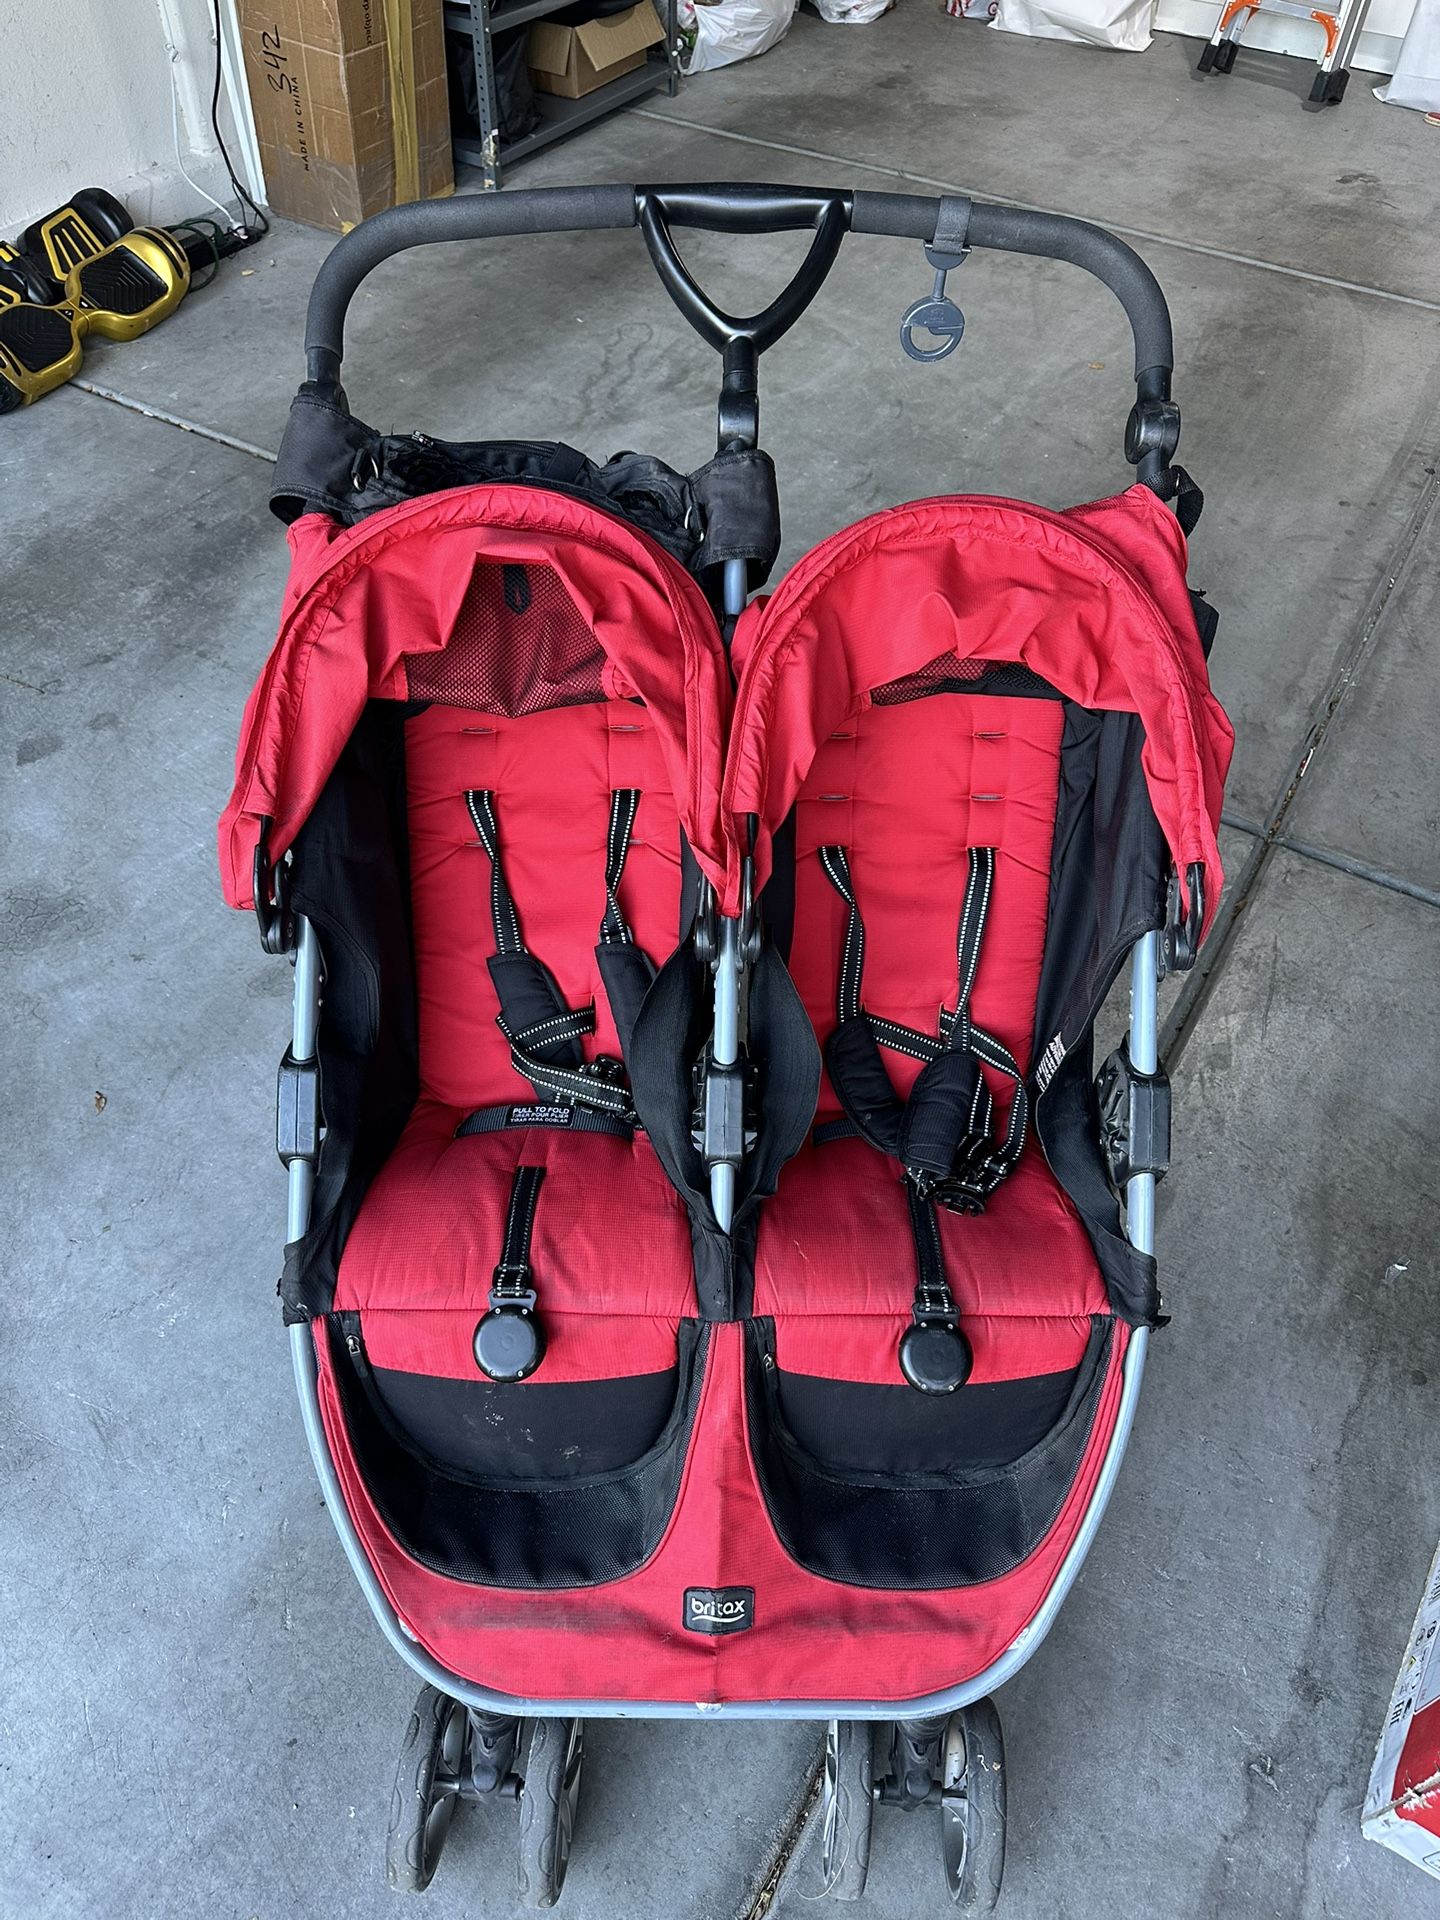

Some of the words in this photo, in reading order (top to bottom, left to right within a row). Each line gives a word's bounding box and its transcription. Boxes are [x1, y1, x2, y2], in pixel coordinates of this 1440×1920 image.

[262, 24, 292, 94] 342
[291, 76, 302, 116] CHINA
[297, 121, 305, 134] IN
[299, 138, 310, 172] MADE
[691, 1598, 745, 1616] britax
